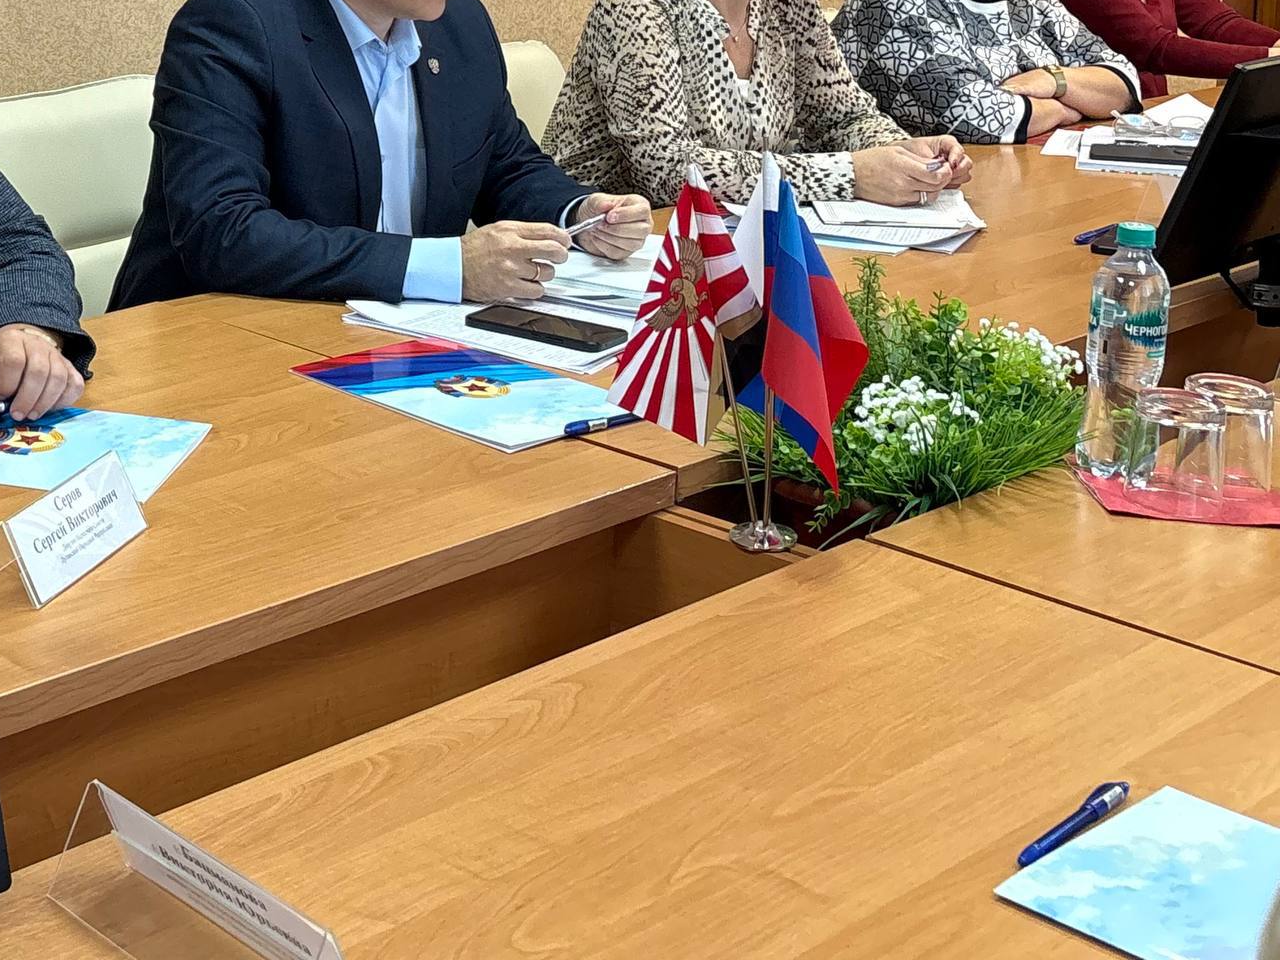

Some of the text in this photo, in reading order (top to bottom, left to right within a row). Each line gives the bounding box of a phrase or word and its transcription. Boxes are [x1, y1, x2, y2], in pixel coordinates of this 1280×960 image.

[33, 522, 68, 554] Сергей
[65, 489, 118, 531] Викторович
[53, 487, 82, 512] Серов
